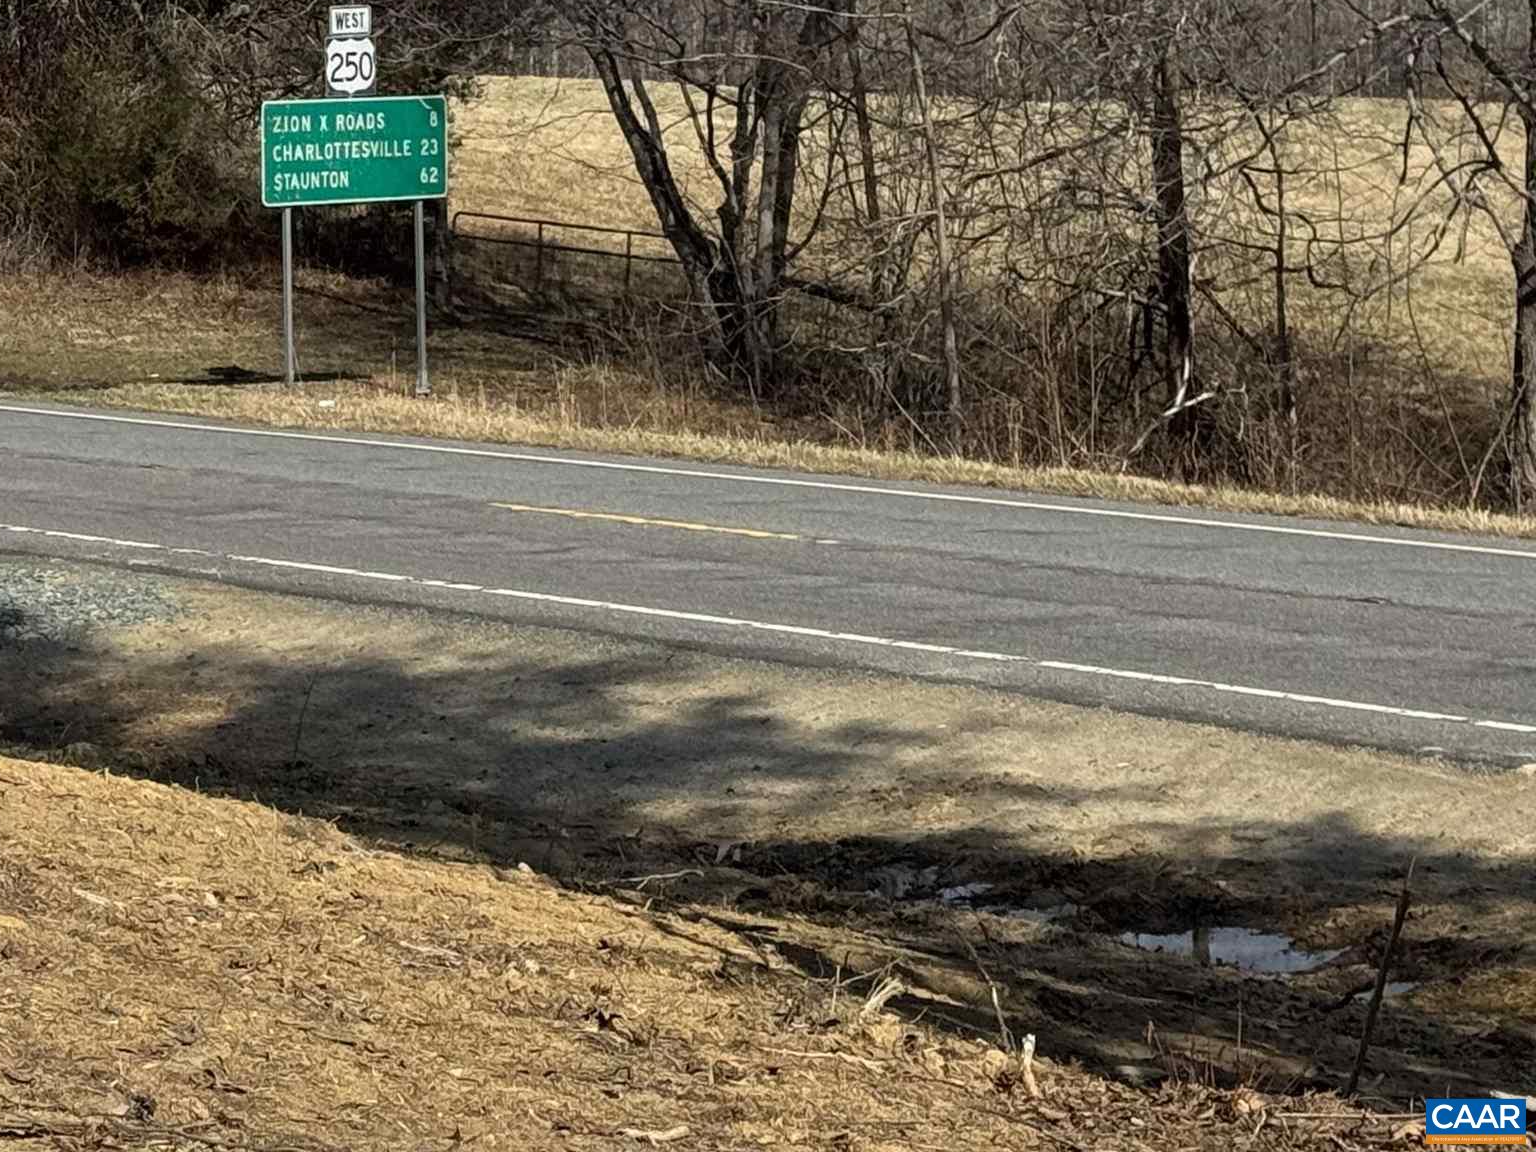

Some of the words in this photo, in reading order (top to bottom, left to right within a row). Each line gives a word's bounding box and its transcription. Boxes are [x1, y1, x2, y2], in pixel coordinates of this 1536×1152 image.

[335, 12, 365, 29] WEST
[330, 51, 373, 83] 250
[272, 115, 311, 133] ZION
[319, 115, 328, 131] X
[336, 113, 385, 130] ROADS
[430, 111, 438, 127] 8
[272, 140, 412, 162] CHARLOTTESVILLE
[420, 138, 438, 156] 23
[273, 171, 349, 191] STAUNTON
[420, 167, 438, 184] 62
